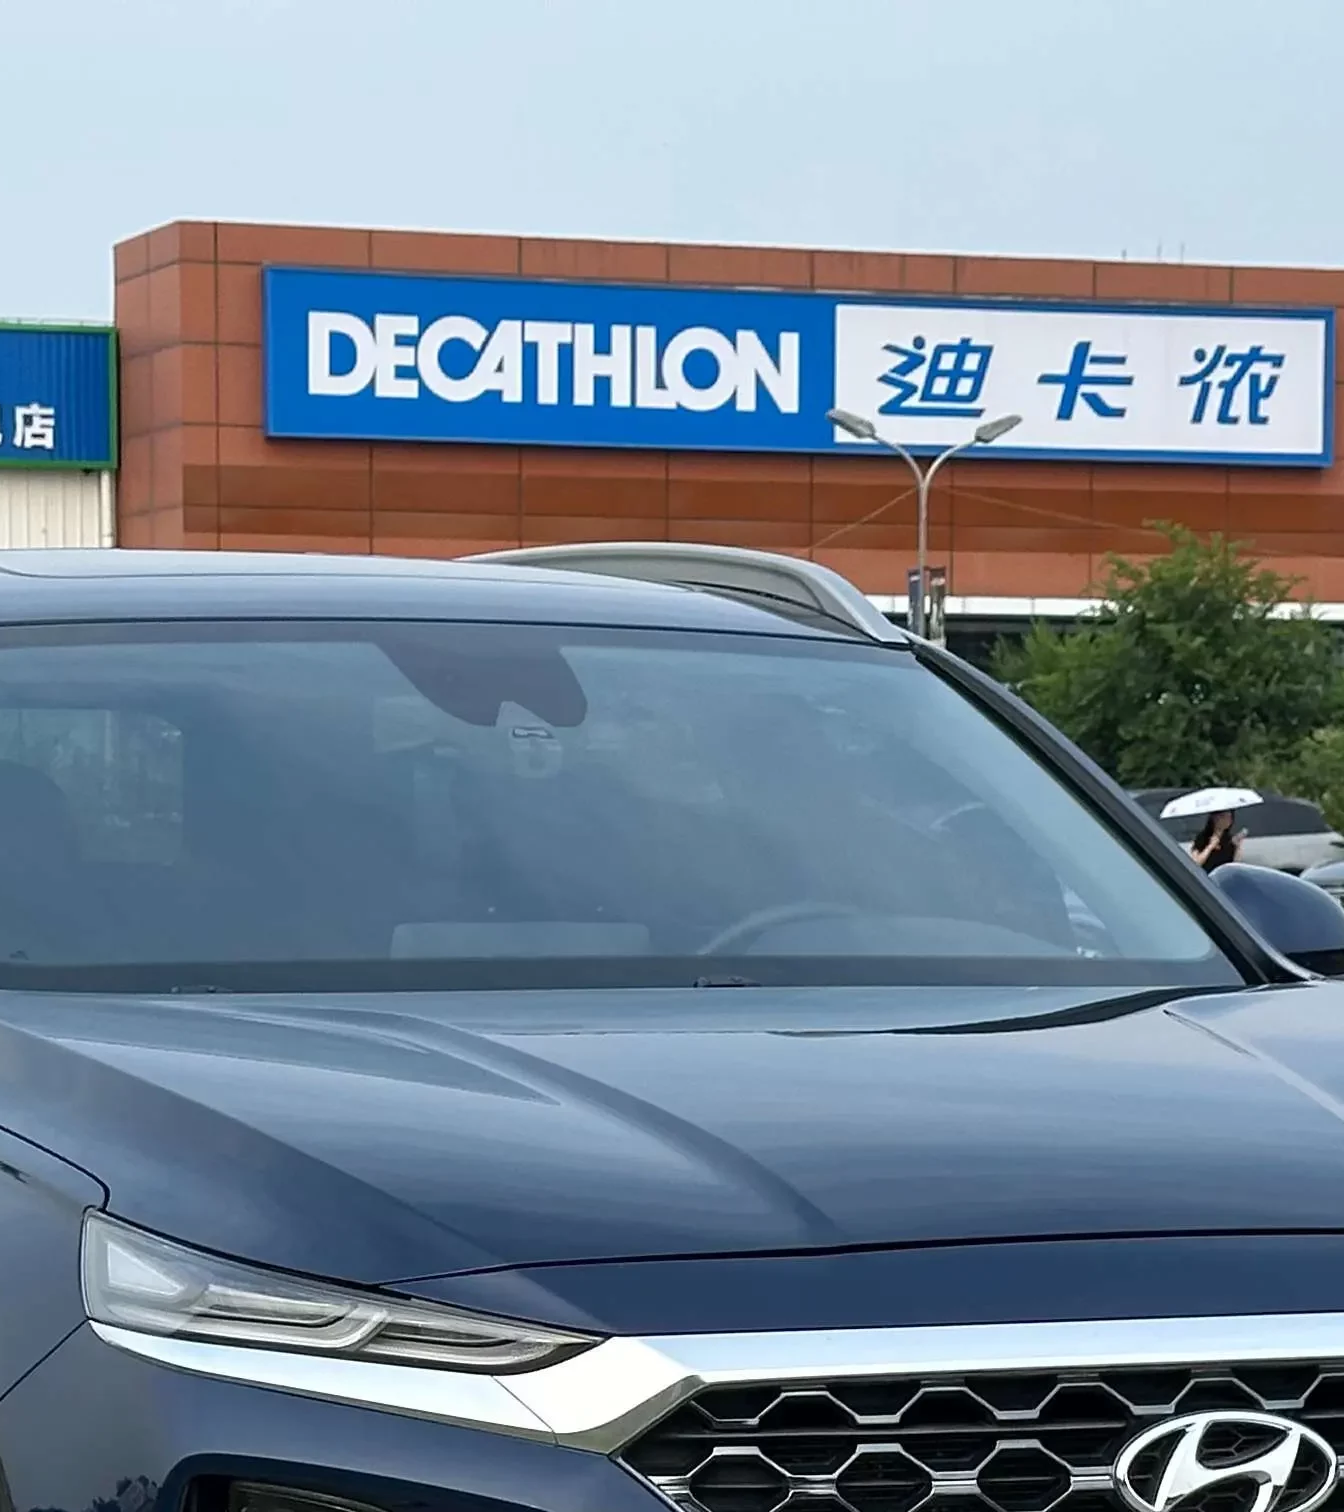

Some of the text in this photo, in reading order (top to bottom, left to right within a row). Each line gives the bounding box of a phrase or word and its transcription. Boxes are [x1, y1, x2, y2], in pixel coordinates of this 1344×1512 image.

[307, 311, 800, 414] DECATHLON
[876, 335, 1286, 425] 迪卡侬
